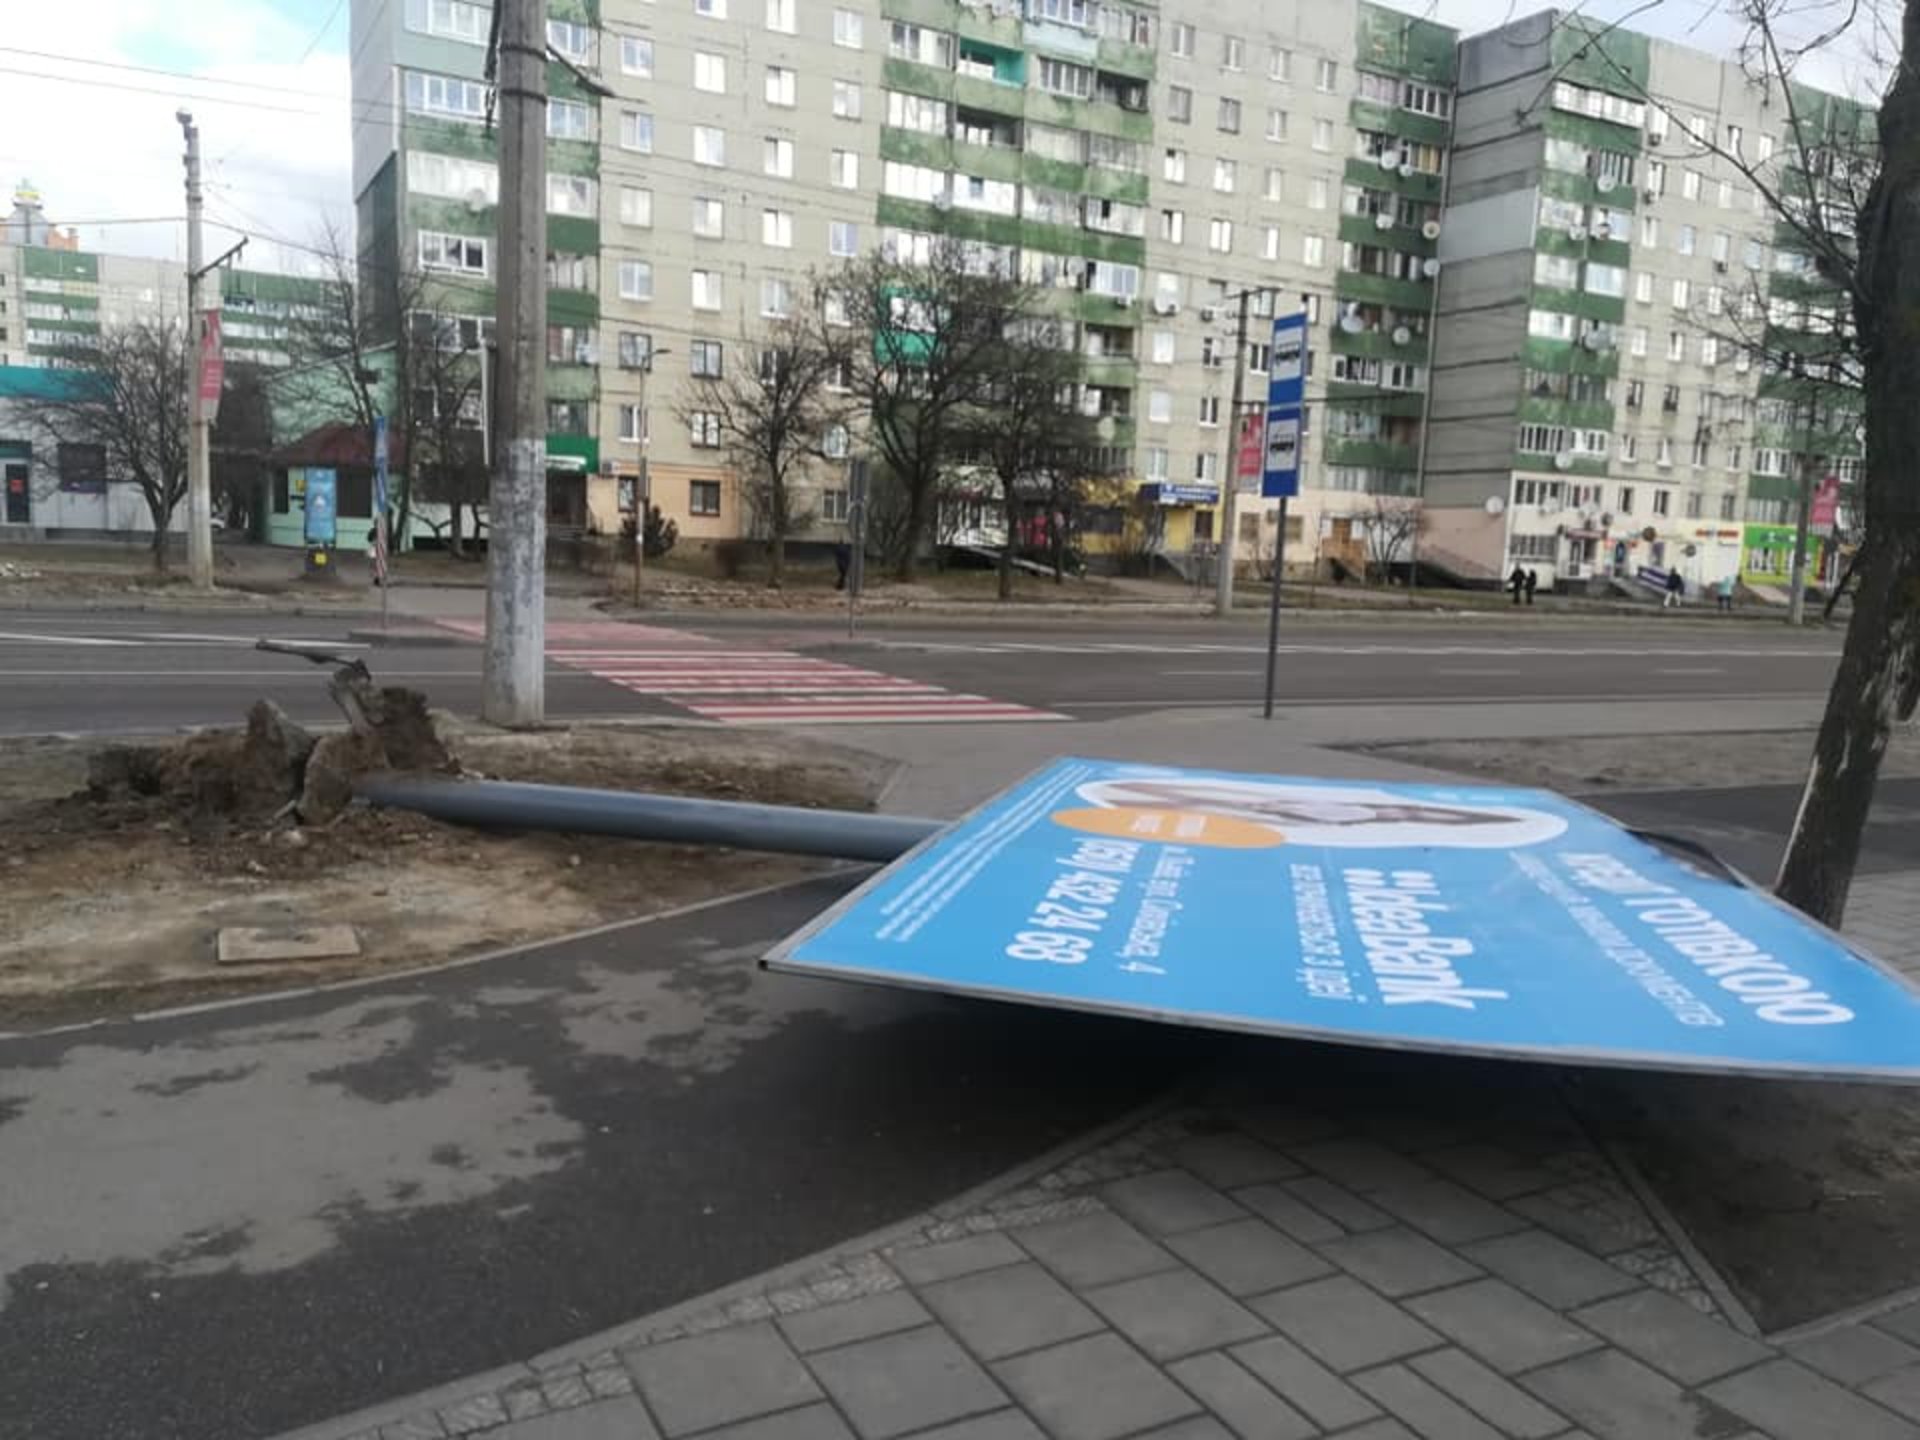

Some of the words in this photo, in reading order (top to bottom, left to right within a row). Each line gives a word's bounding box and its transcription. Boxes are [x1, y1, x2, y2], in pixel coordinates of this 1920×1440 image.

[1046, 870, 1124, 904] 432
[1027, 900, 1108, 931] 24
[1005, 930, 1094, 964] 68
[1624, 897, 1855, 1024] ГОТІВКОЮ
